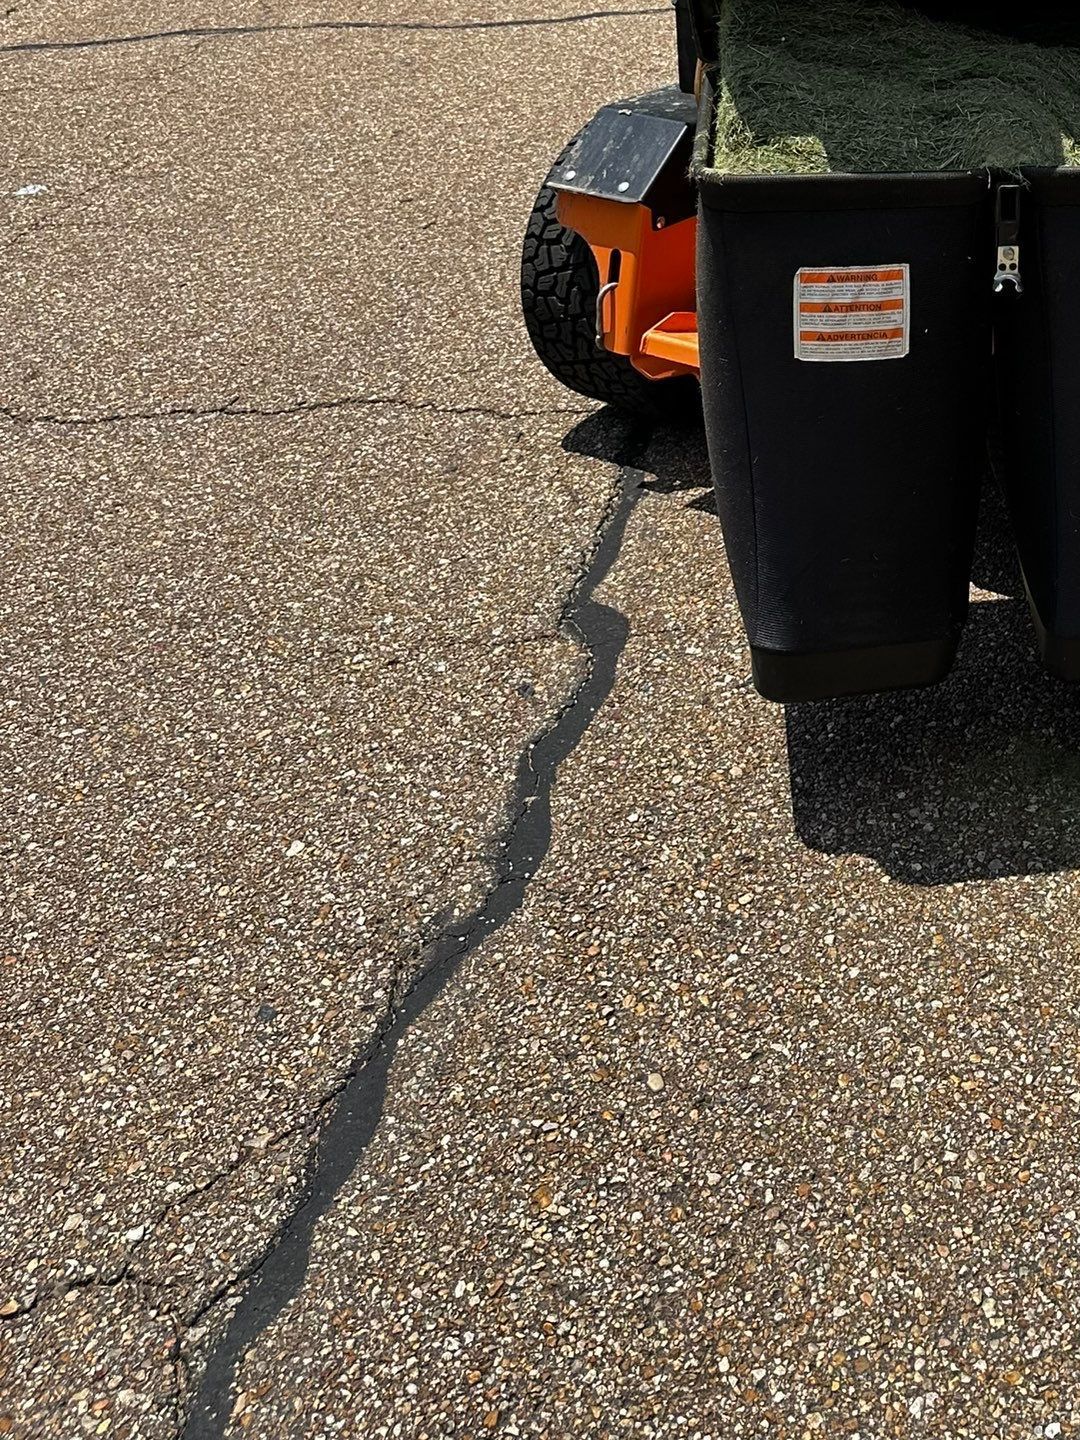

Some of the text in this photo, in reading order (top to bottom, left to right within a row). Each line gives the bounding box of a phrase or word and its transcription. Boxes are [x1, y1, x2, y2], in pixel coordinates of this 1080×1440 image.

[836, 273, 878, 283] WARNING
[833, 303, 882, 312] ATTENTION
[827, 331, 888, 341] ADVERTENCIA
